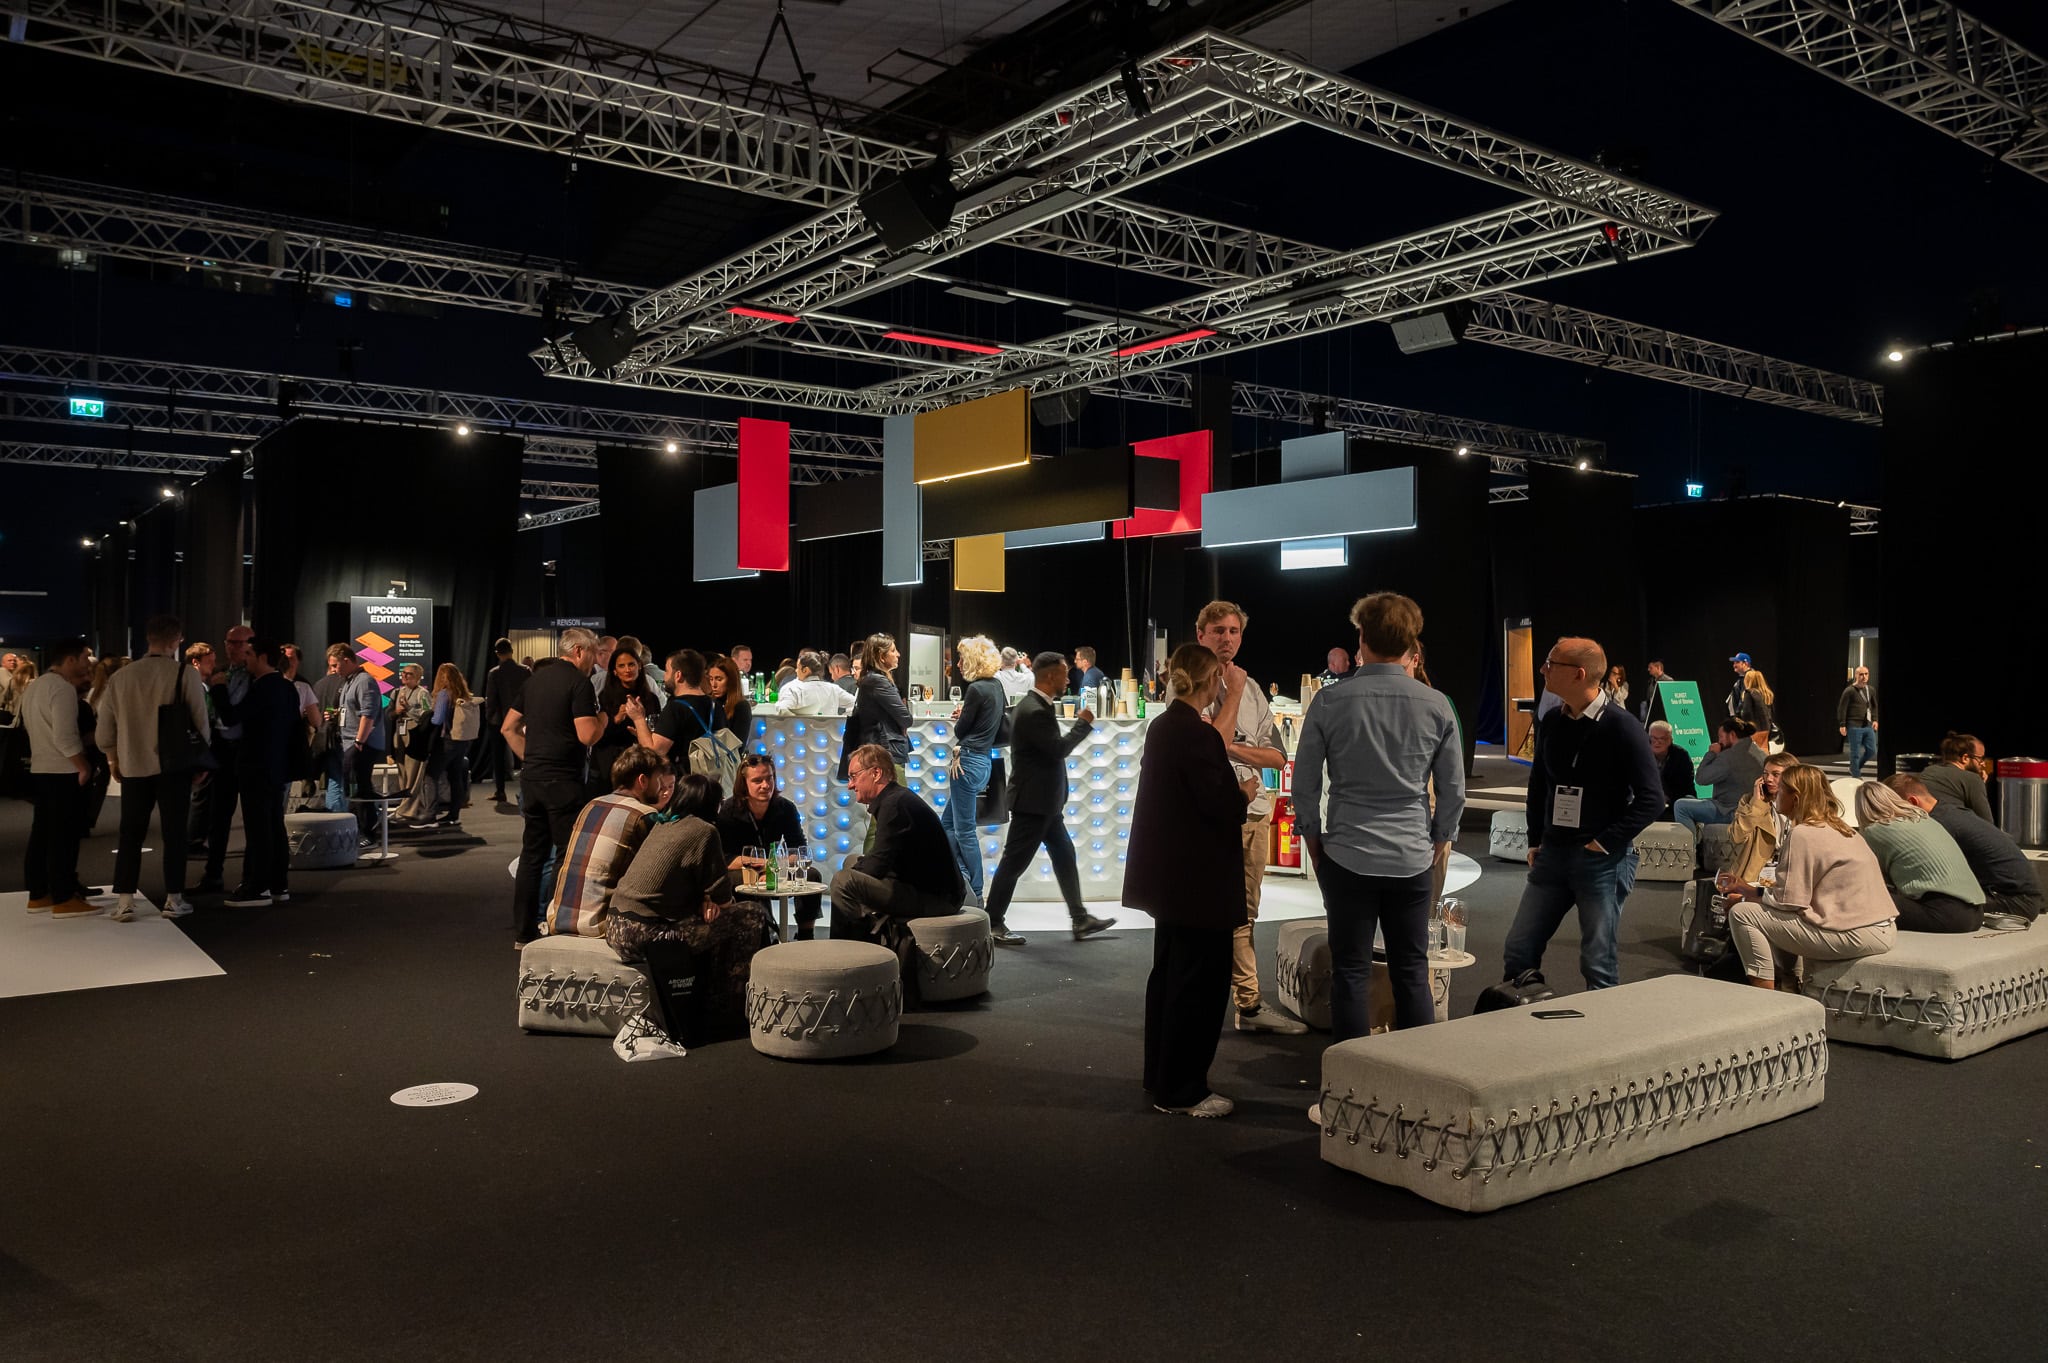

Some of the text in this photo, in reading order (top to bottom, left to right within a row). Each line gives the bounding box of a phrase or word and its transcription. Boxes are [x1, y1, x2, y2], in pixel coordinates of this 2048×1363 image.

[366, 605, 417, 615] UPCOMING
[370, 615, 414, 624] EDITIONS
[556, 618, 581, 626] RENSON
[1684, 728, 1704, 736] academy
